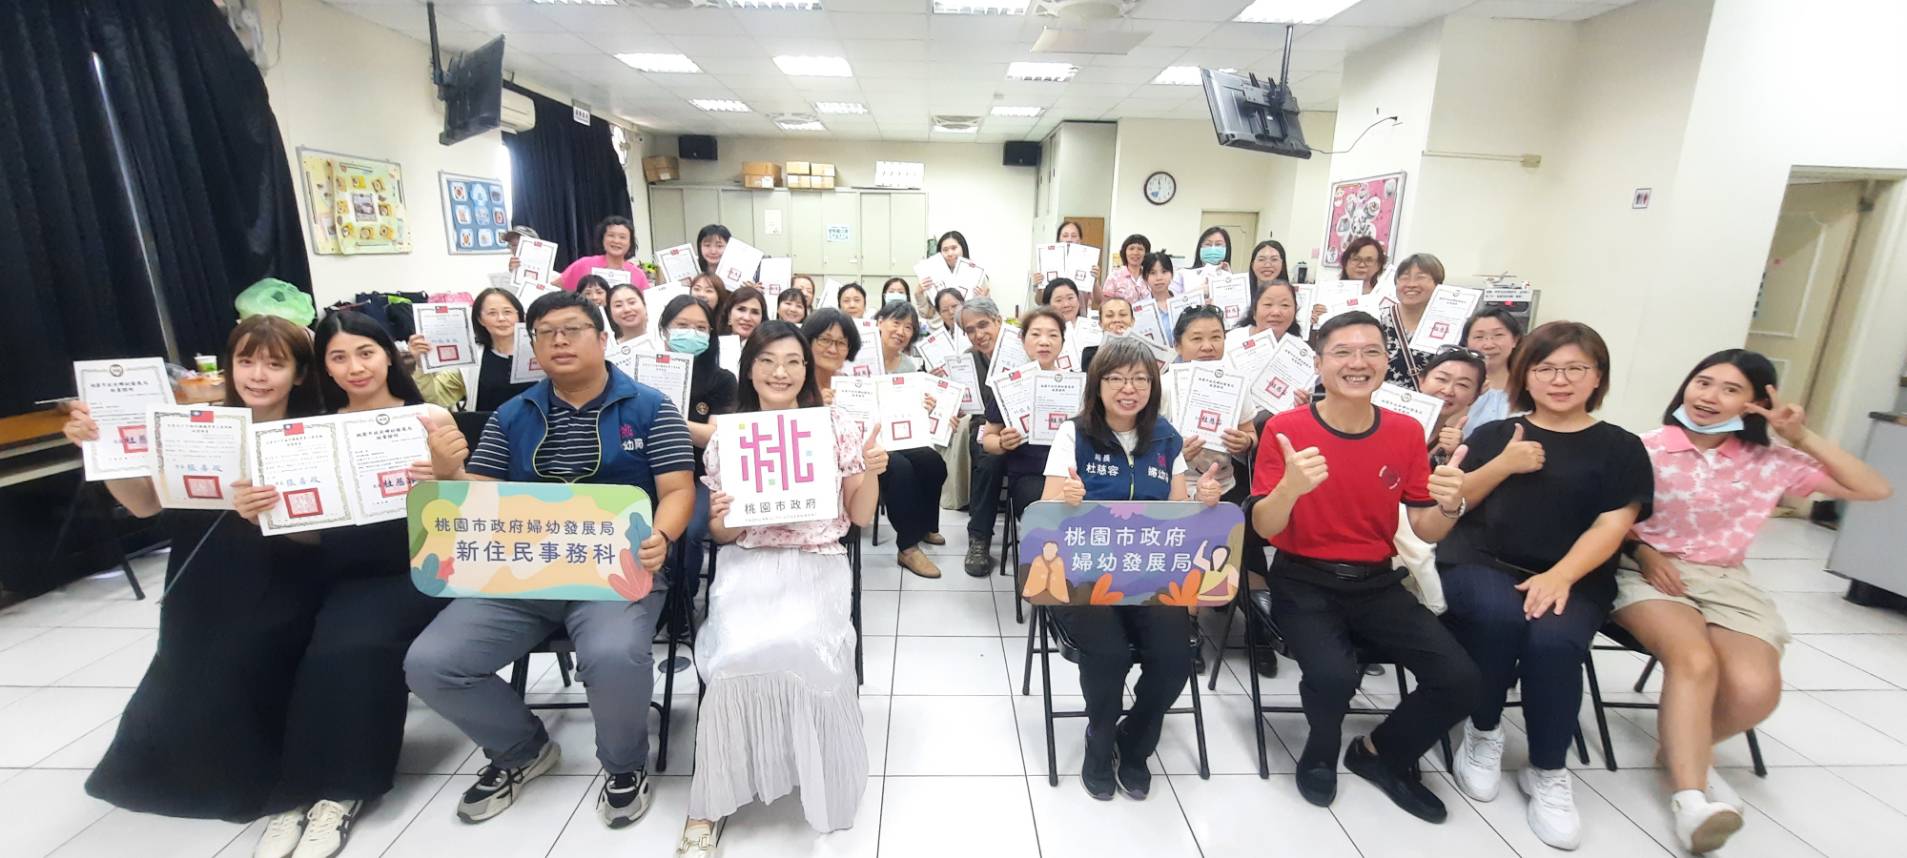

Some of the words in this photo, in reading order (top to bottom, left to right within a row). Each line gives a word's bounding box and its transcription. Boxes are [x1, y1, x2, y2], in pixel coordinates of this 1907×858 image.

[1086, 462, 1120, 477] 杜慈容
[744, 498, 817, 515] 桃園市政府
[434, 517, 616, 536] 桃園市政府婦幼發展局
[1063, 526, 1188, 548] 桃園市政府
[456, 540, 617, 565] 新住民事務科
[1071, 552, 1193, 573] 婦幼發展局
